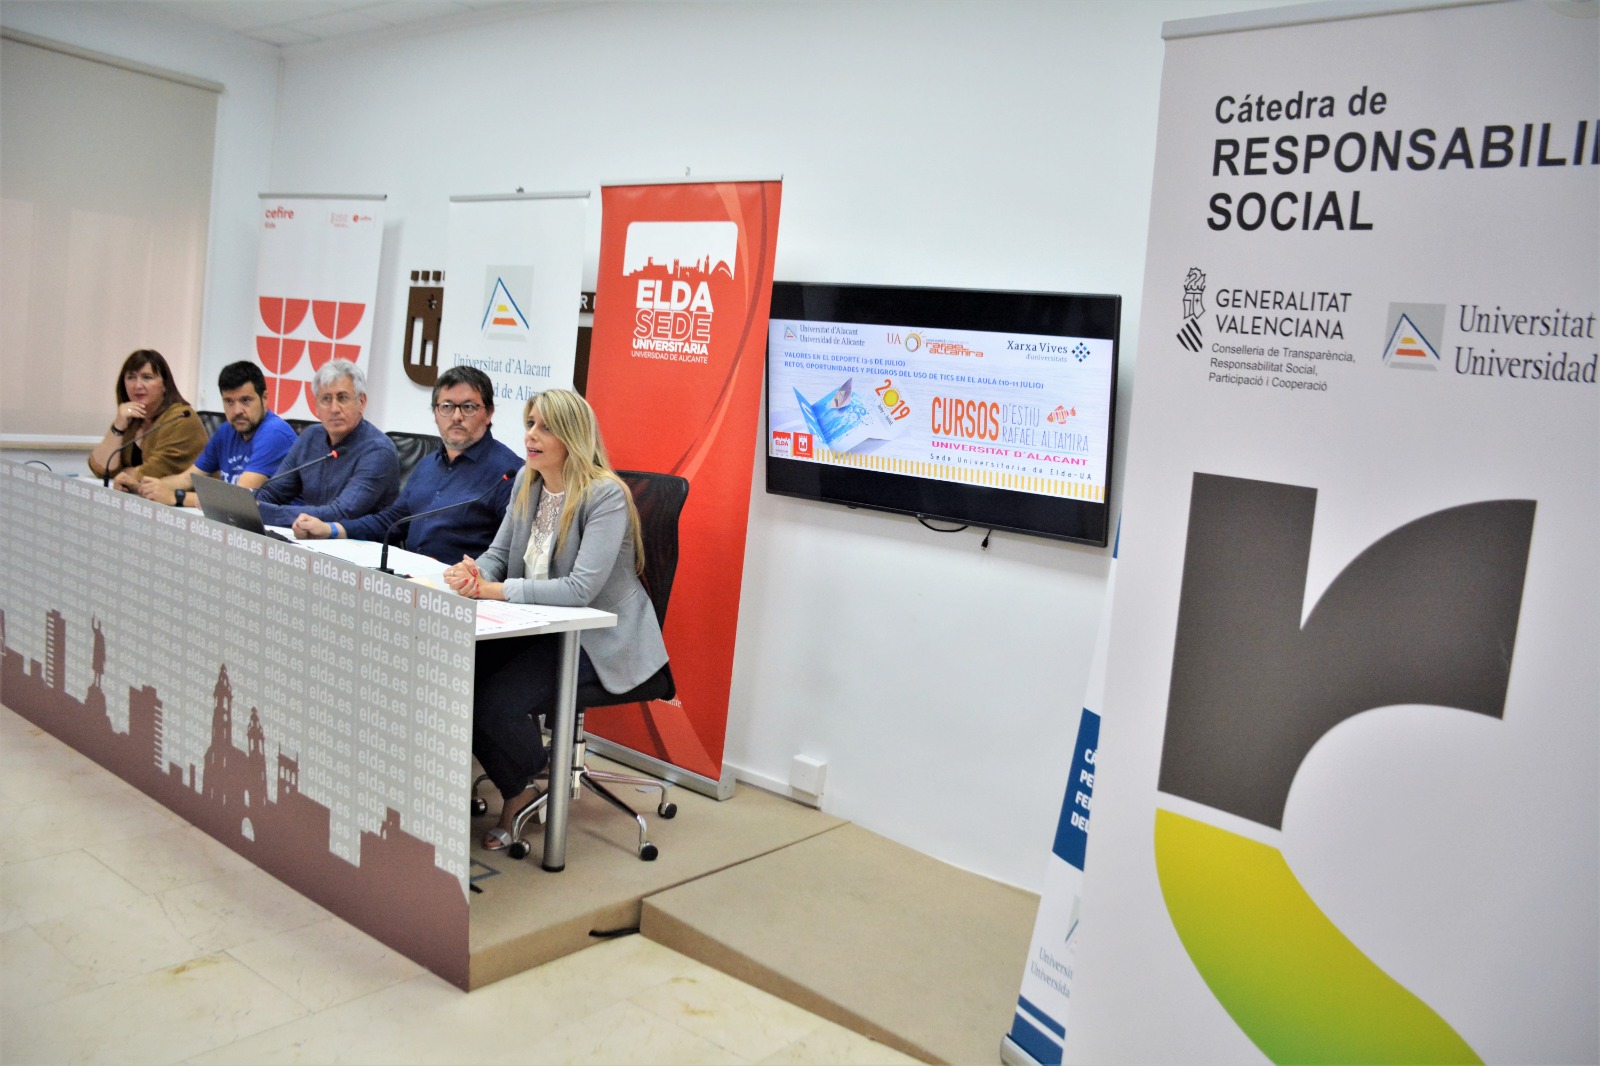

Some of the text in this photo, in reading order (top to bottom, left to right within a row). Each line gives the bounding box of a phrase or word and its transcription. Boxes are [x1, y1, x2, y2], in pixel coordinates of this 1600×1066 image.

[1215, 86, 1387, 124] Cátedra de
[1207, 190, 1373, 231] SOCIAL
[636, 279, 714, 312] ELDA
[1216, 288, 1352, 312] GENERALITAT
[634, 309, 712, 344] SEDE
[800, 324, 830, 334] Universitat
[1216, 314, 1344, 340] VALENCIANA
[1459, 304, 1596, 339] Universitat
[632, 338, 708, 355] UNIVERSITARIA
[800, 335, 866, 346] Universidad de Alicante
[887, 332, 901, 345] UA
[1006, 340, 1068, 354] Xarxa Vives
[1211, 342, 1356, 363] Conselleria de Transparència,
[454, 353, 552, 378] Universitat d'Alacant
[679, 354, 708, 364] ALICANTE
[784, 352, 812, 360] VALORES
[812, 352, 820, 360] EN
[822, 353, 829, 361] EL
[831, 354, 860, 363] DEPORTE
[874, 358, 884, 366] DE
[884, 359, 906, 368] JULIO)
[1026, 354, 1068, 363] d'universitats
[1210, 358, 1318, 376] Responsabilitat Social,
[1455, 346, 1598, 384] Universidad
[806, 362, 859, 372] OPORTUNIDADES
[866, 366, 898, 376] PELIGROS
[898, 370, 912, 378] DEL
[913, 372, 927, 380] USO
[928, 372, 938, 380] DE
[940, 374, 954, 382] TICS
[956, 374, 966, 382] EN
[968, 376, 976, 384] EL
[978, 377, 996, 386] AULA
[1020, 380, 1044, 390] JULIO)
[1208, 372, 1328, 392] Participació i Cooperació
[502, 384, 512, 399] de
[931, 396, 1000, 441] CURSOS
[931, 440, 1088, 466] UNIVERSITAT D'ALACANT
[1002, 426, 1089, 452] RAFAEL ALTAMIRA
[93, 489, 120, 508] elda.es
[124, 498, 152, 519] elda.es
[157, 508, 186, 530] elda.es
[191, 519, 222, 542] elda.es
[228, 532, 263, 556] elda.es
[268, 547, 306, 570] elda.es
[313, 560, 357, 586] elda.es
[364, 574, 411, 604] elda.es
[419, 592, 473, 623] elda.es
[267, 567, 306, 590] elda.es
[313, 581, 356, 608] elda.es
[363, 596, 410, 626] elda.es
[419, 615, 472, 647] elda.es
[267, 586, 305, 611] elda.es
[312, 601, 355, 629] elda.es
[362, 618, 410, 648] elda.es
[418, 638, 471, 670] elda.es
[267, 606, 304, 631] elda.es
[312, 622, 355, 650] elda.es
[362, 640, 409, 671] elda.es
[417, 660, 470, 693] elda.es
[266, 625, 304, 651] elda.es
[311, 643, 354, 671] elda.es
[361, 662, 408, 693] elda.es
[417, 683, 470, 716] elda.es
[266, 645, 303, 671] elda.es
[311, 664, 353, 692] elda.es
[361, 684, 408, 715] elda.es
[416, 706, 469, 740] elda.es
[265, 664, 302, 691] elda.es
[310, 684, 353, 713] elda.es
[360, 705, 407, 737] elda.es
[416, 728, 468, 763] elda.es
[265, 684, 467, 786] elda.es elda.es elda.es elda.es
[264, 703, 467, 810] elda.es elda.es elda.es elda.es
[264, 723, 466, 833] elda.es elda.es elda.es elda.es
[308, 767, 465, 856] elda.es elda.es
